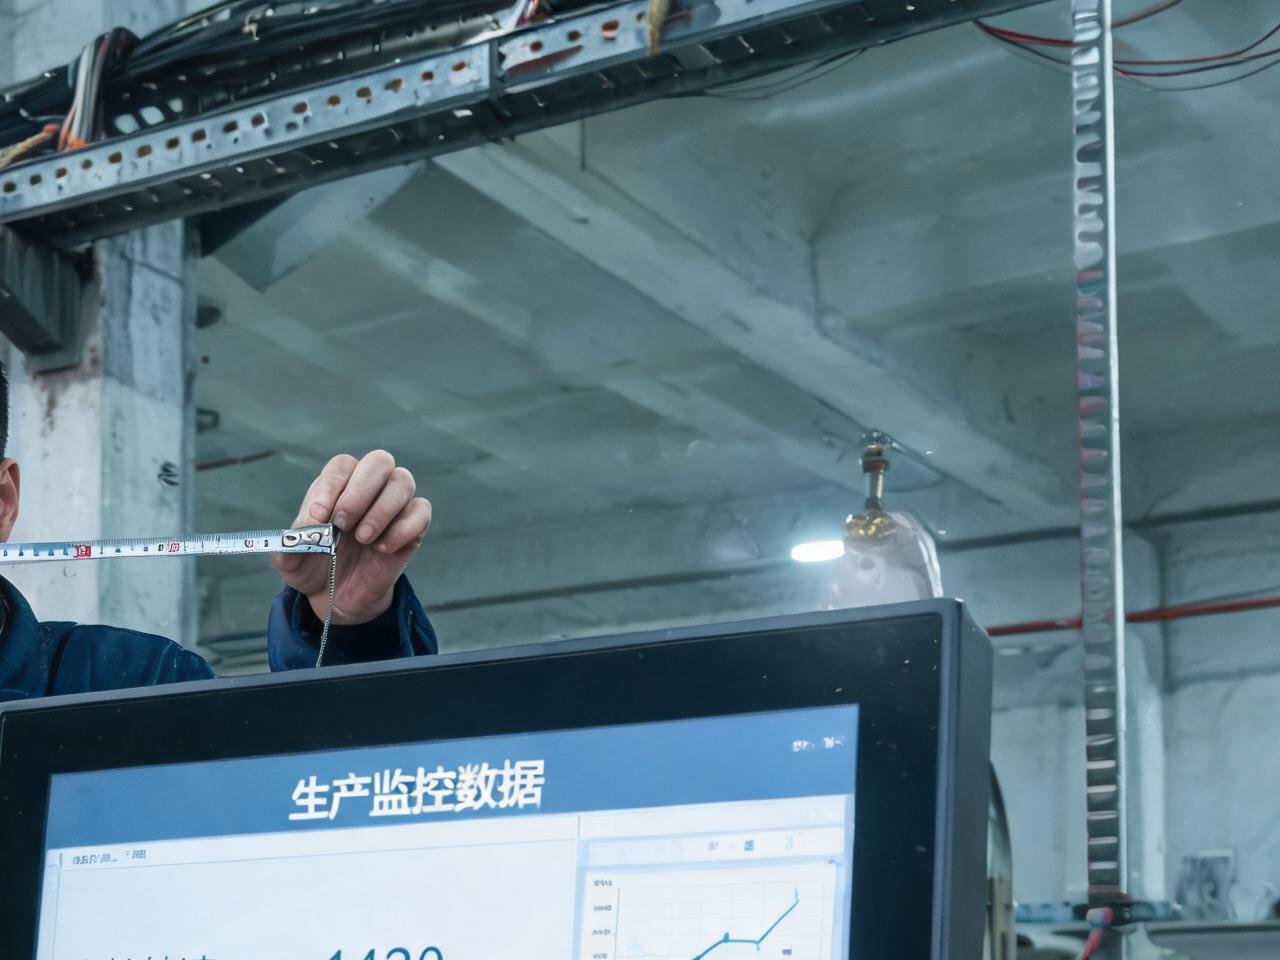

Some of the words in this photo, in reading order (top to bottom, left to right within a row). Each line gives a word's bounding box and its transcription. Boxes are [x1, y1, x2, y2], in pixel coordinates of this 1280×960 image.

[288, 759, 545, 821] 生产监控数据
